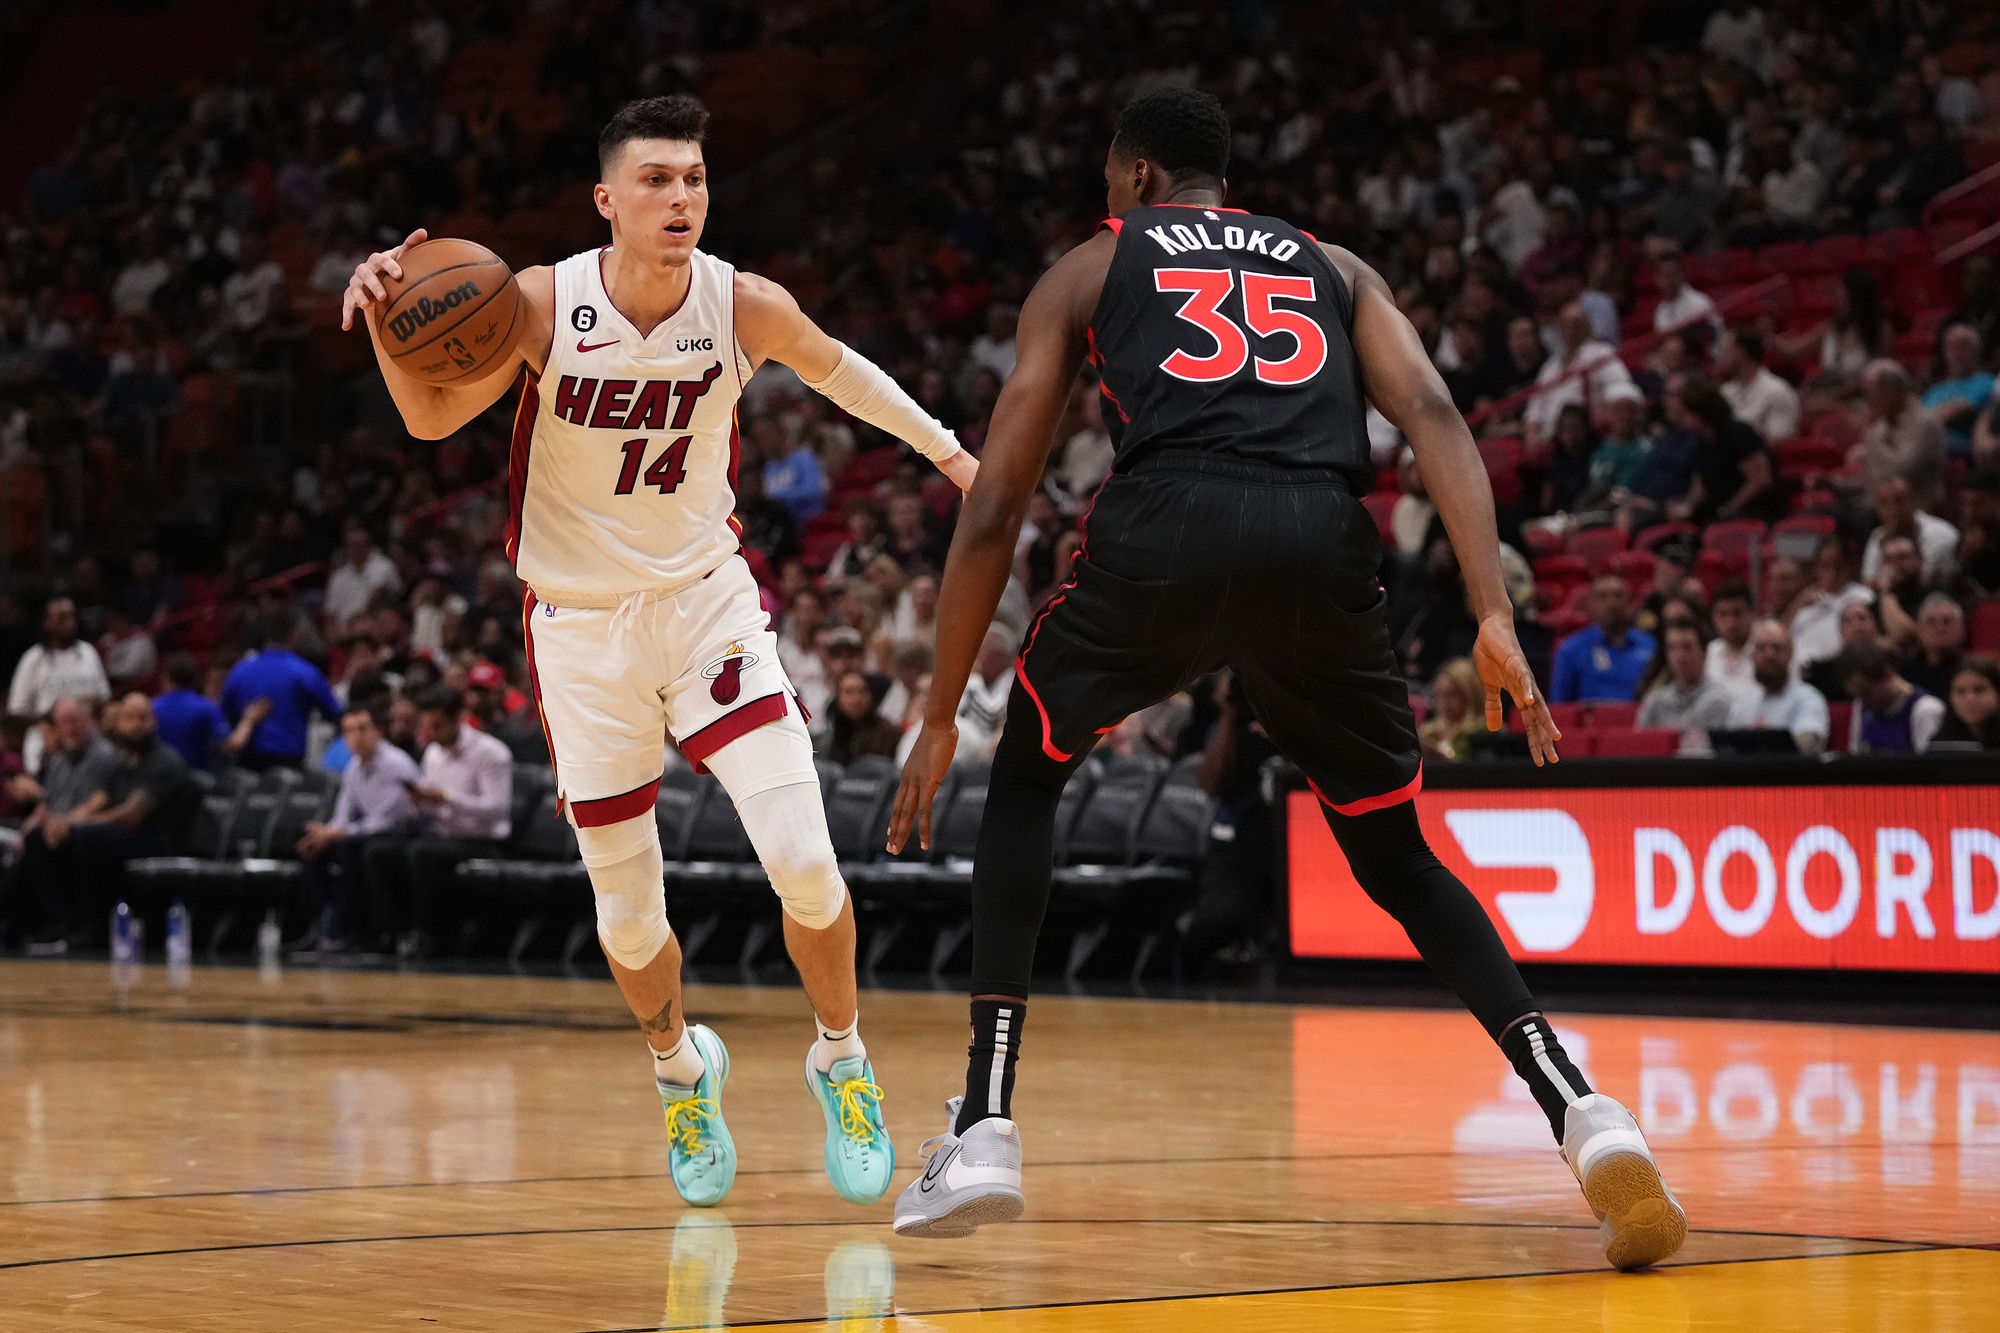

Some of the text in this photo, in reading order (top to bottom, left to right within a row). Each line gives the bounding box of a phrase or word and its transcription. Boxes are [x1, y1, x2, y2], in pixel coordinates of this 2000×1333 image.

[1144, 223, 1301, 262] KOLOKO
[388, 281, 482, 343] Wilson
[577, 308, 593, 330] 6
[1152, 267, 1329, 386] 35
[554, 360, 723, 430] HEAT
[614, 435, 694, 495] 14
[1634, 825, 2000, 941] DOORD
